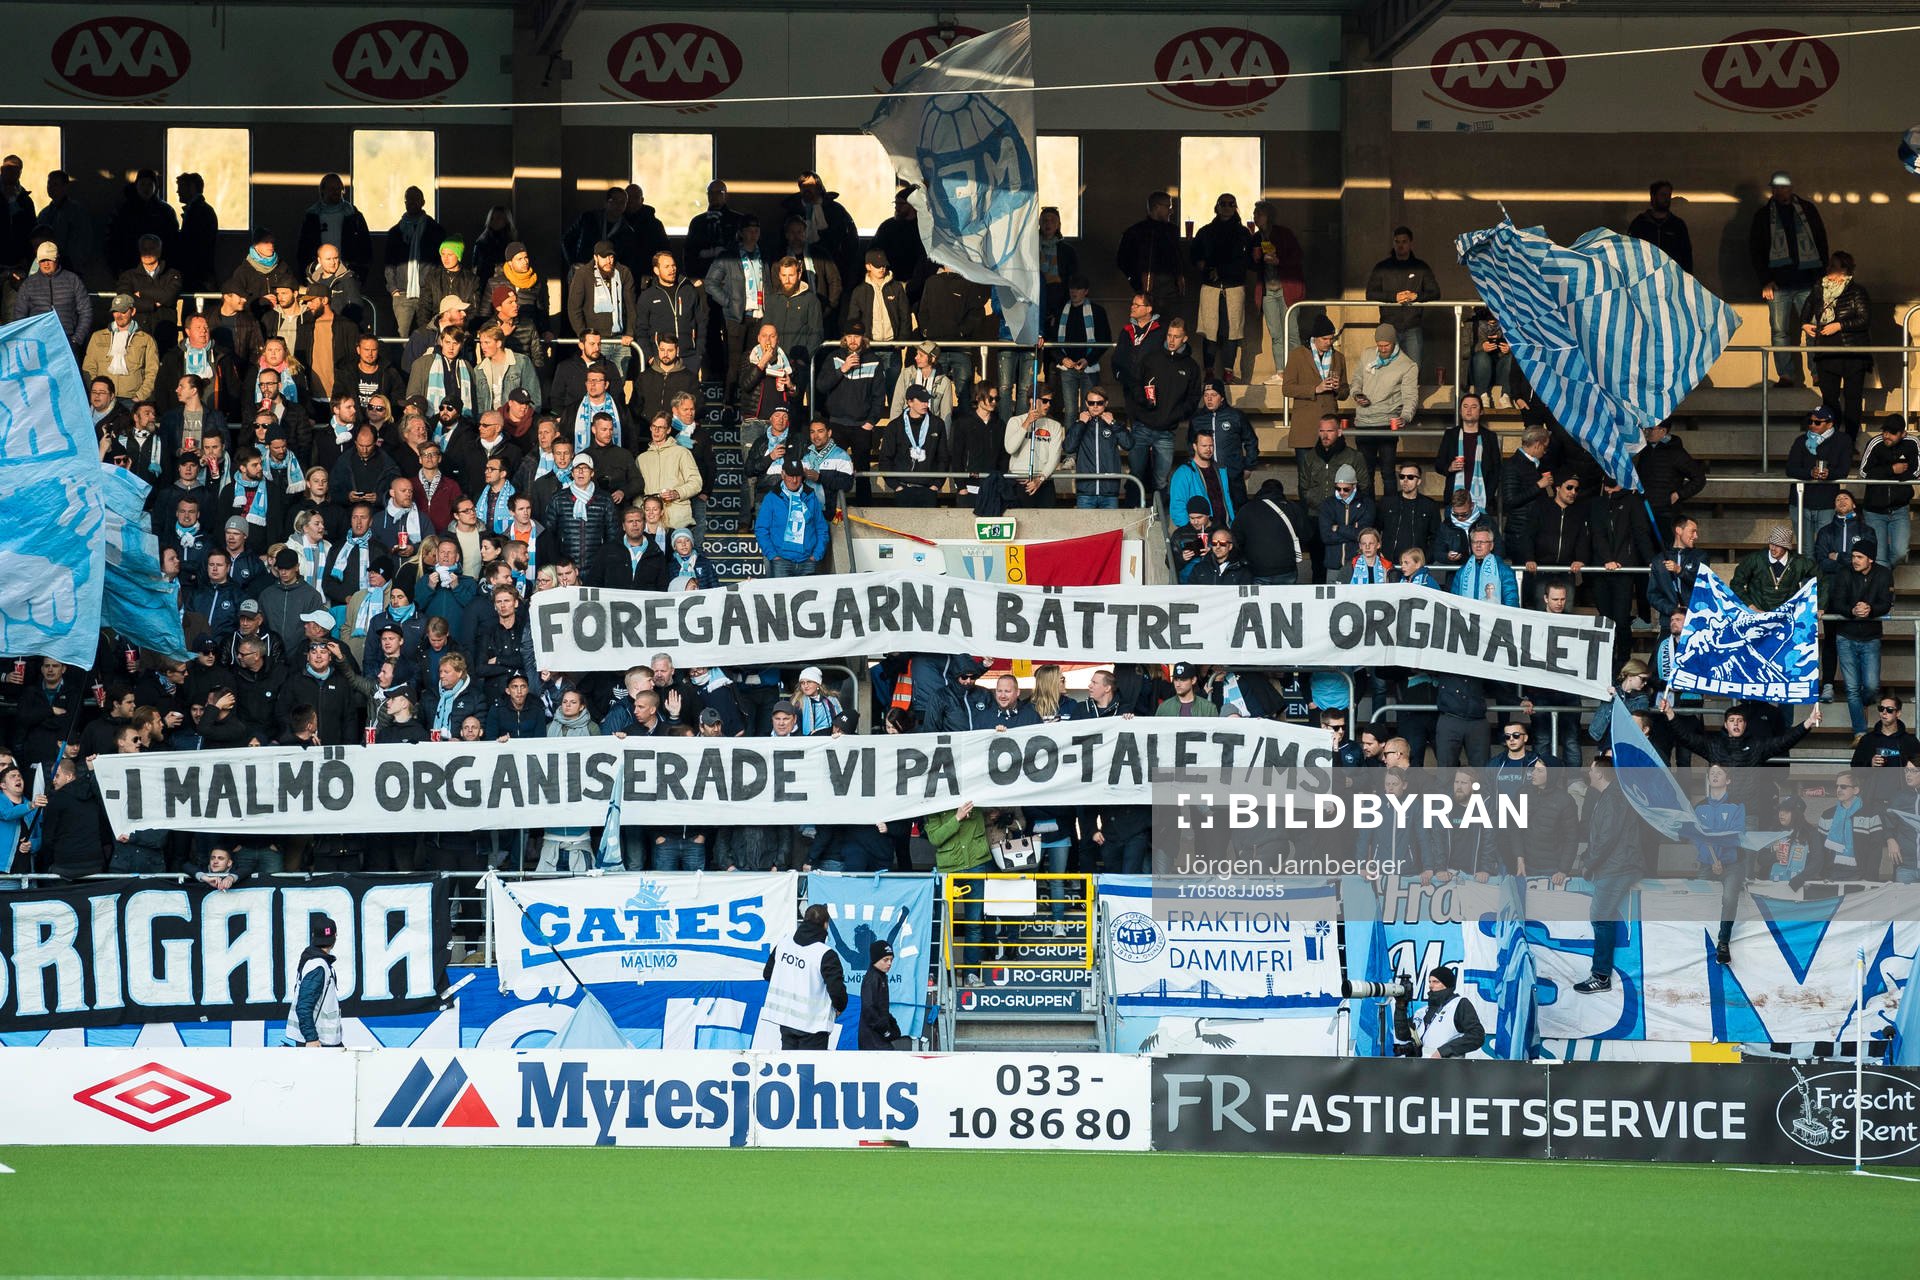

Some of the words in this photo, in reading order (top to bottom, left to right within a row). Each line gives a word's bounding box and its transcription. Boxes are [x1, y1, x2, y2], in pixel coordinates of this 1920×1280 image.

[64, 28, 178, 78] AXA
[344, 30, 456, 81] AXA
[618, 32, 731, 85] AXA
[1166, 36, 1278, 88] AXA
[1441, 38, 1553, 89] AXA
[1713, 38, 1827, 89] AXA
[538, 581, 972, 652] FÖREGÅNGARNA
[996, 586, 1203, 652] BÄTTRE
[1231, 586, 1303, 649] ÄN
[1673, 669, 1810, 698] SUPRAS
[164, 746, 355, 818] MALMÖ
[375, 748, 808, 812] ORGANISERADE
[825, 747, 876, 798] VI
[895, 735, 962, 798] PÅ
[1119, 928, 1152, 942] MFF
[1168, 911, 1290, 933] FRAKTION
[0, 883, 437, 1016] RIGADA
[781, 952, 806, 969] FOTO
[1170, 948, 1292, 972] DAMMFRI
[980, 995, 1072, 1007] RO-GRUPPEN
[518, 1062, 918, 1147] Myresjöhus
[1164, 1073, 1257, 1133] FR
[1266, 1093, 1747, 1140] FASTIGHETSSERVICE
[1815, 1087, 1916, 1111] Fräscht
[950, 1108, 997, 1140] 10
[1010, 1108, 1063, 1140] 86
[1076, 1108, 1131, 1141] 80
[1830, 1118, 1850, 1141] &
[1860, 1119, 1919, 1142] Rent
